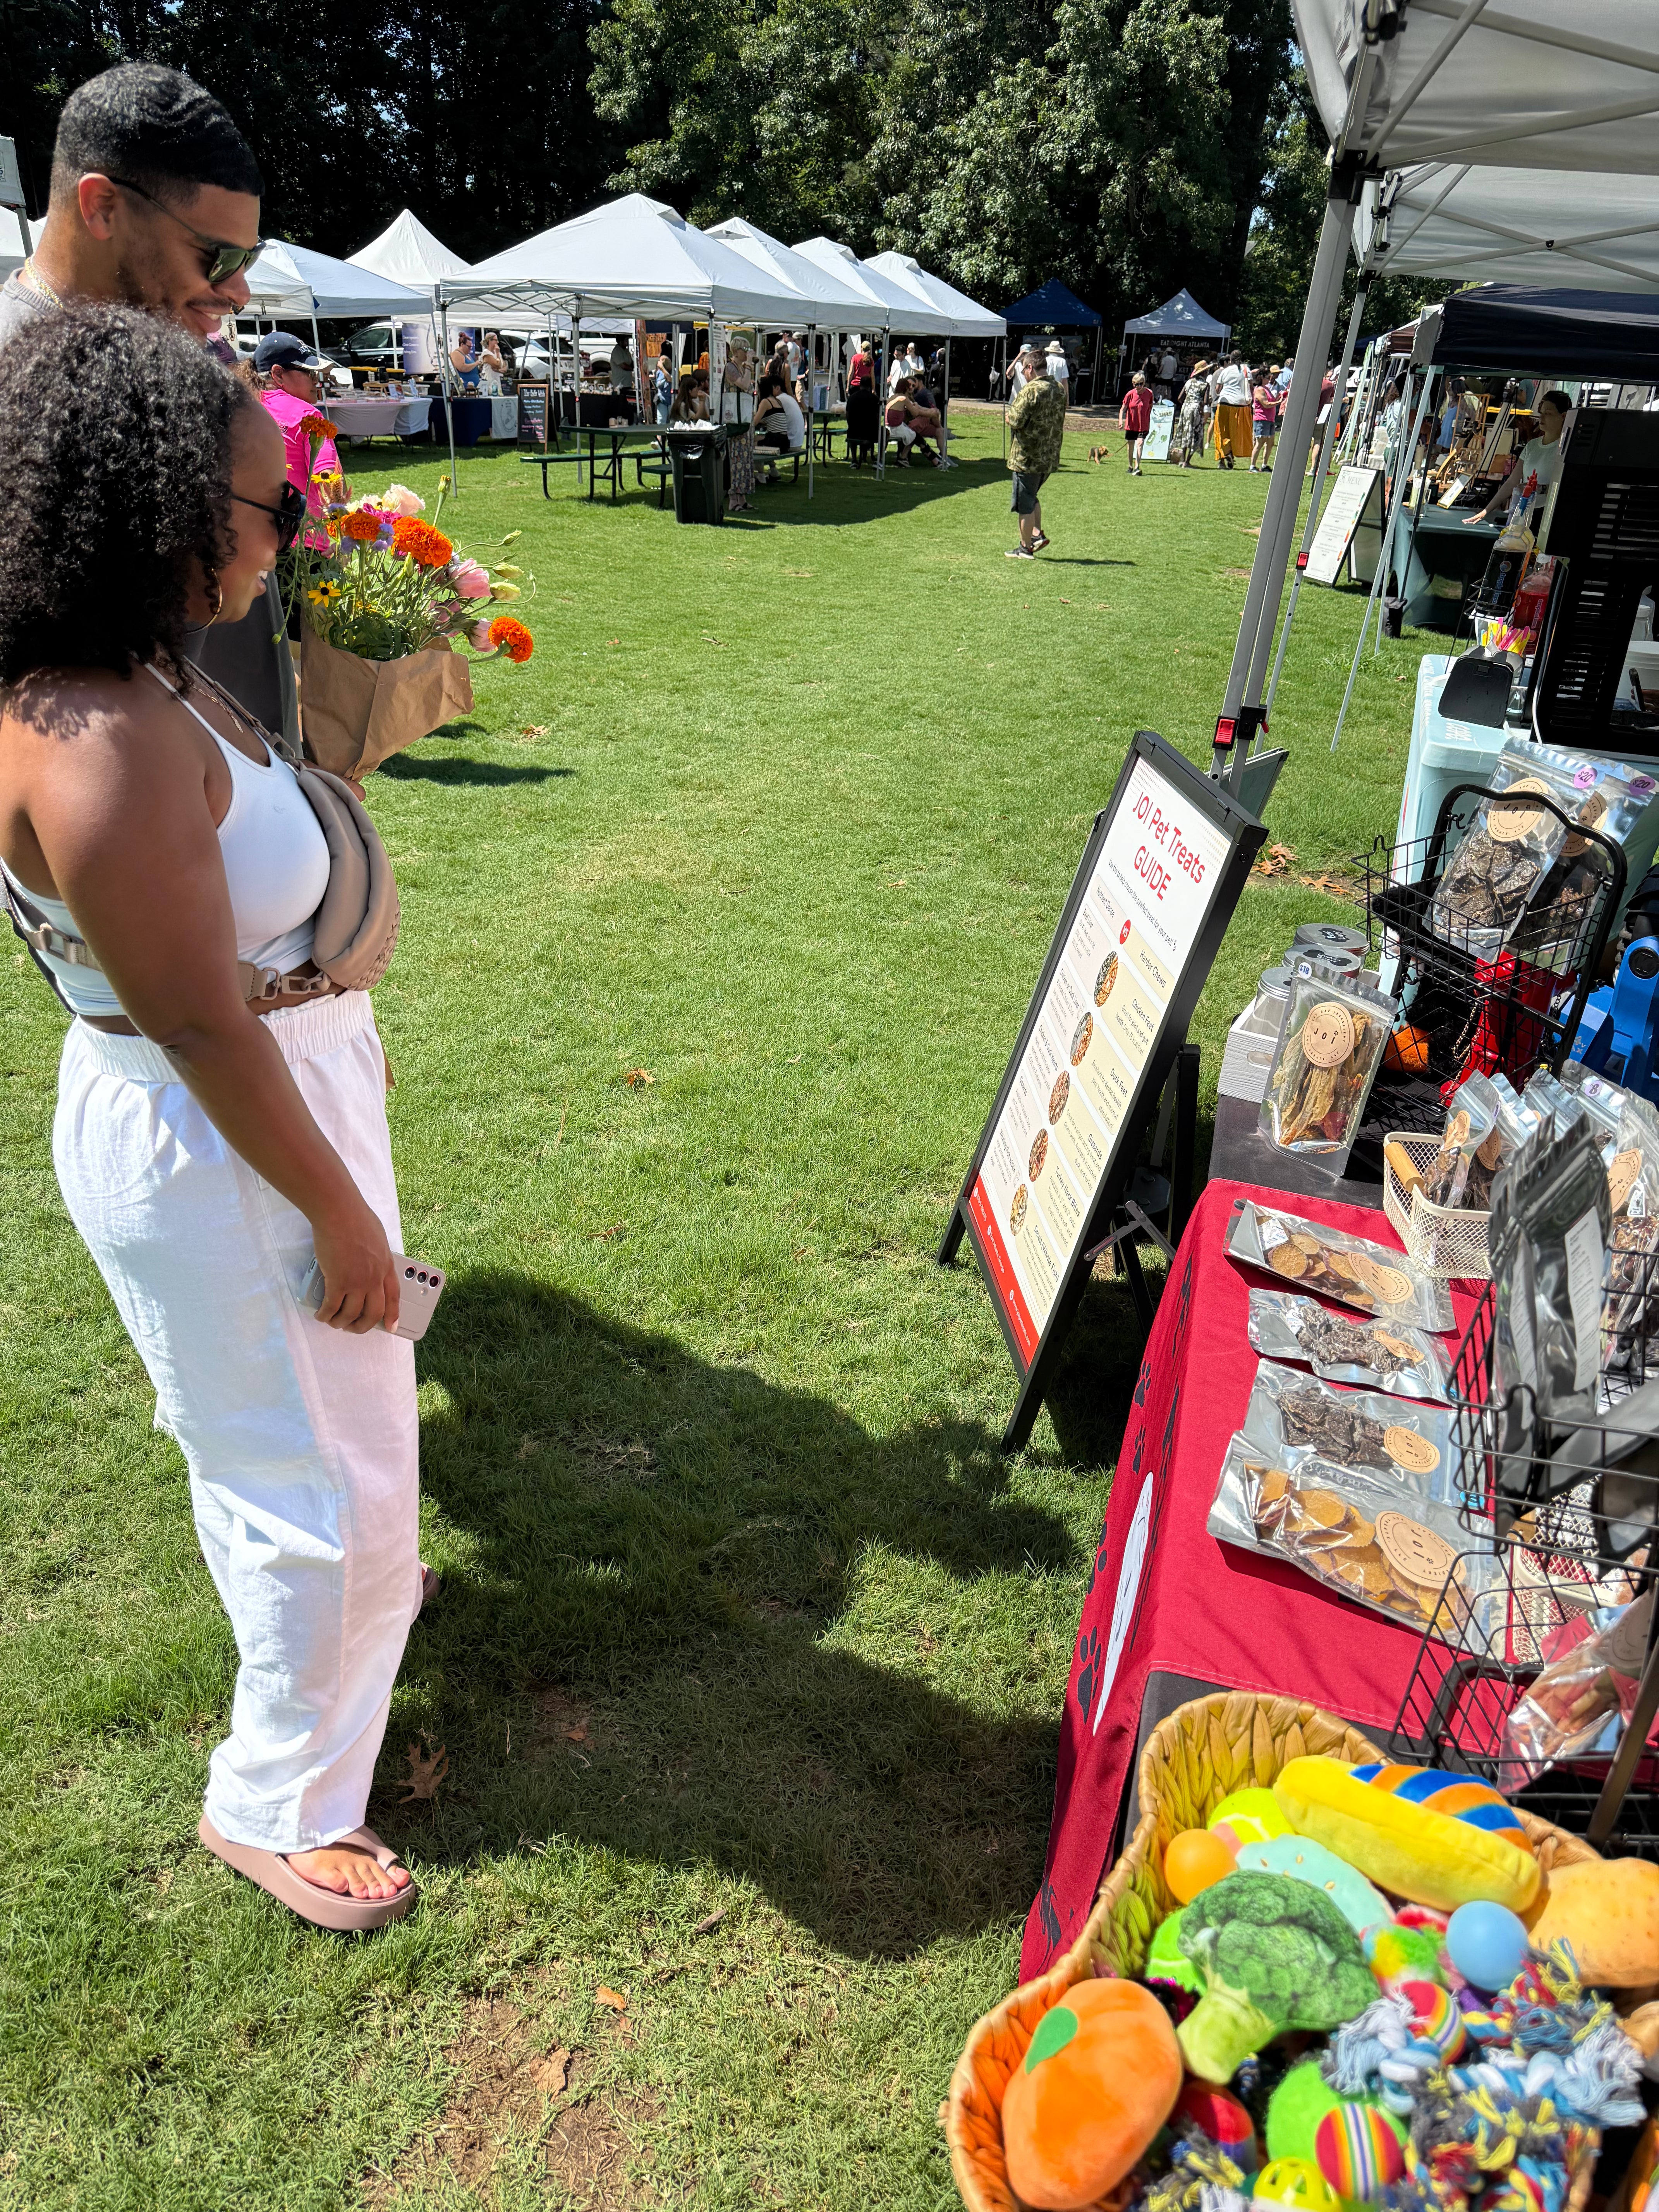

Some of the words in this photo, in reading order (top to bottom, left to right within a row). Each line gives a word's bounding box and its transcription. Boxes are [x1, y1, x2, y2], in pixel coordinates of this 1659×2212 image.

[1346, 476, 1362, 485] MENU
[1578, 771, 1593, 783] $20
[1632, 779, 1651, 789] $20
[1132, 791, 1153, 824] JOI
[1148, 808, 1169, 845] Pet
[1168, 826, 1205, 883] Treats
[1134, 845, 1171, 900] GUIDE
[1096, 885, 1107, 906] Nutrient
[1106, 900, 1115, 917] Dense
[1124, 881, 1133, 895] choose
[1135, 898, 1147, 915] pawfect
[1158, 926, 1166, 938] your
[1164, 935, 1173, 946] pet!
[1122, 925, 1128, 938] VS
[1140, 949, 1153, 971] Harder
[1152, 966, 1166, 988] Chews
[1300, 964, 1310, 975] $18
[1132, 998, 1145, 1020] Chicken
[1144, 1015, 1154, 1032] Feet
[1128, 1032, 1133, 1040] 75
[1132, 1037, 1144, 1056] kcal/foot
[1314, 1028, 1335, 1044] JOI
[1092, 1060, 1102, 1079] Excellent
[1104, 1082, 1113, 1096] dental
[1110, 1068, 1119, 1085] Duck
[1118, 1080, 1127, 1097] Feet
[1108, 1104, 1118, 1120] mental
[1082, 1139, 1090, 1155] lasting
[1088, 1133, 1102, 1159] Gizzards
[1075, 1142, 1085, 1162] Available
[1087, 1164, 1096, 1182] chicken,
[1049, 1175, 1058, 1195] Available
[1055, 1166, 1065, 1188] Turkey
[1064, 1184, 1072, 1202] Neck
[1071, 1198, 1080, 1217] Bites
[1041, 1242, 1051, 1266] (Whole
[1051, 1263, 1059, 1282] Fish)
[1371, 1266, 1380, 1286] JOI
[1405, 1435, 1413, 1455] JOI
[1410, 1529, 1425, 1559] JOI
